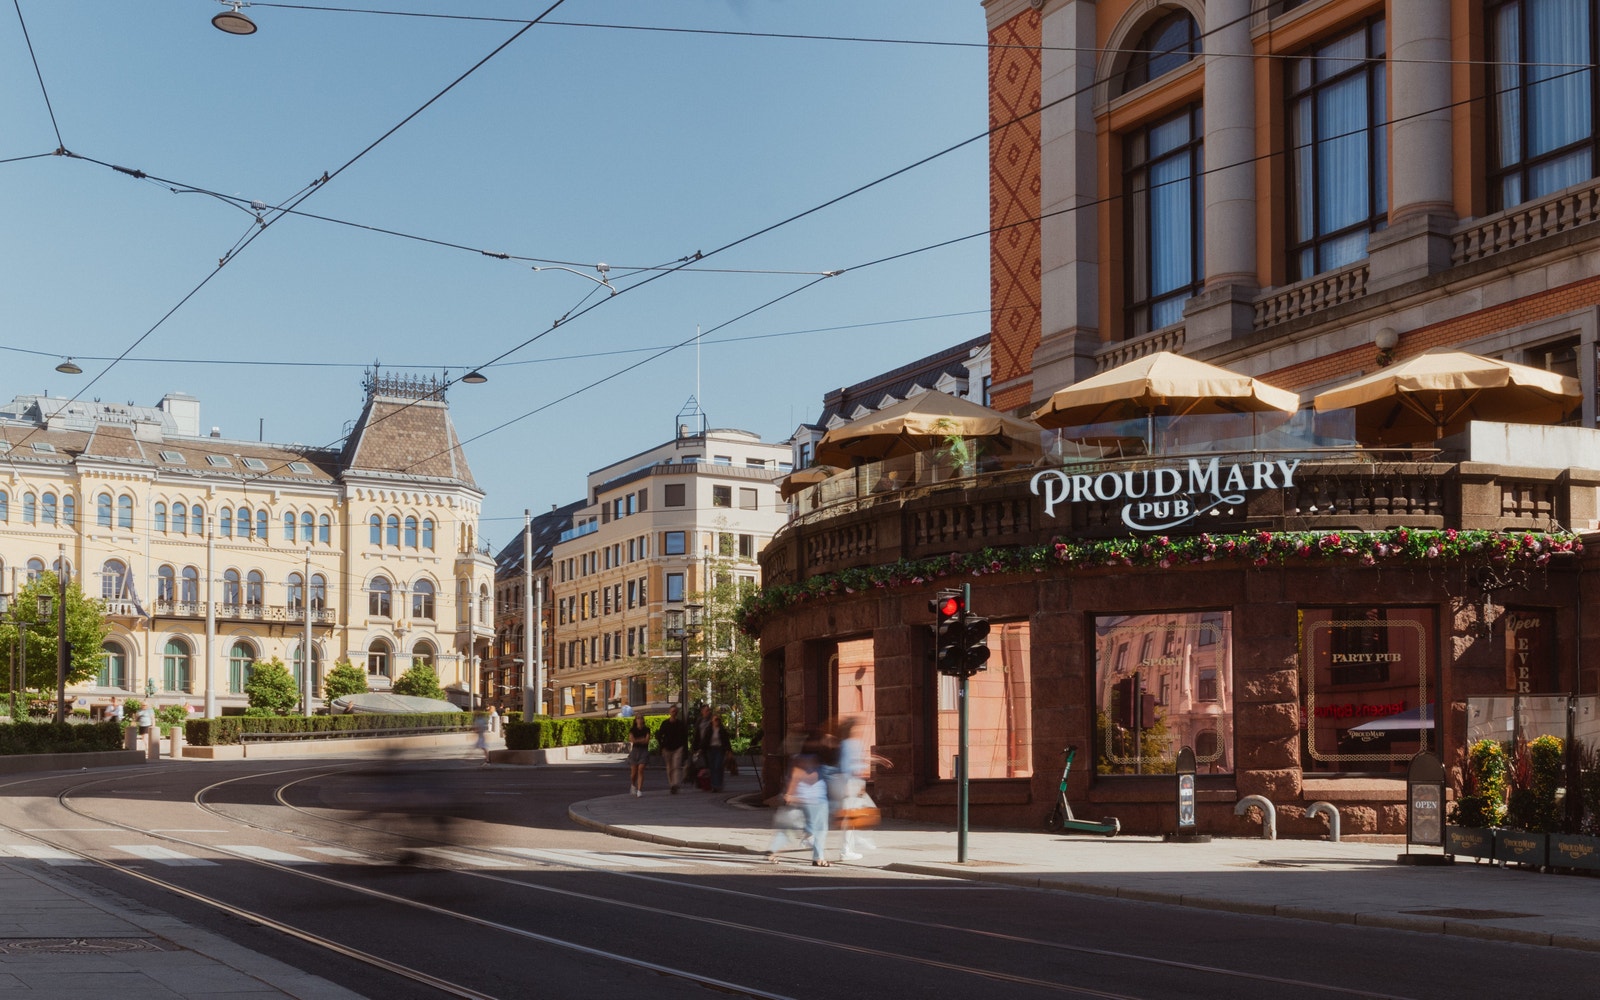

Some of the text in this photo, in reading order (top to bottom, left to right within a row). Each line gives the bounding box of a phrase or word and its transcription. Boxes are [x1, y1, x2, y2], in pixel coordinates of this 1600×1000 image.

[1030, 457, 1300, 518] PROUD MARY
[1138, 499, 1189, 519] PUB
[1506, 613, 1541, 635] Open
[1142, 657, 1184, 667] SPORT
[1332, 653, 1401, 663] PARTY PUB
[1415, 801, 1437, 809] OPEN
